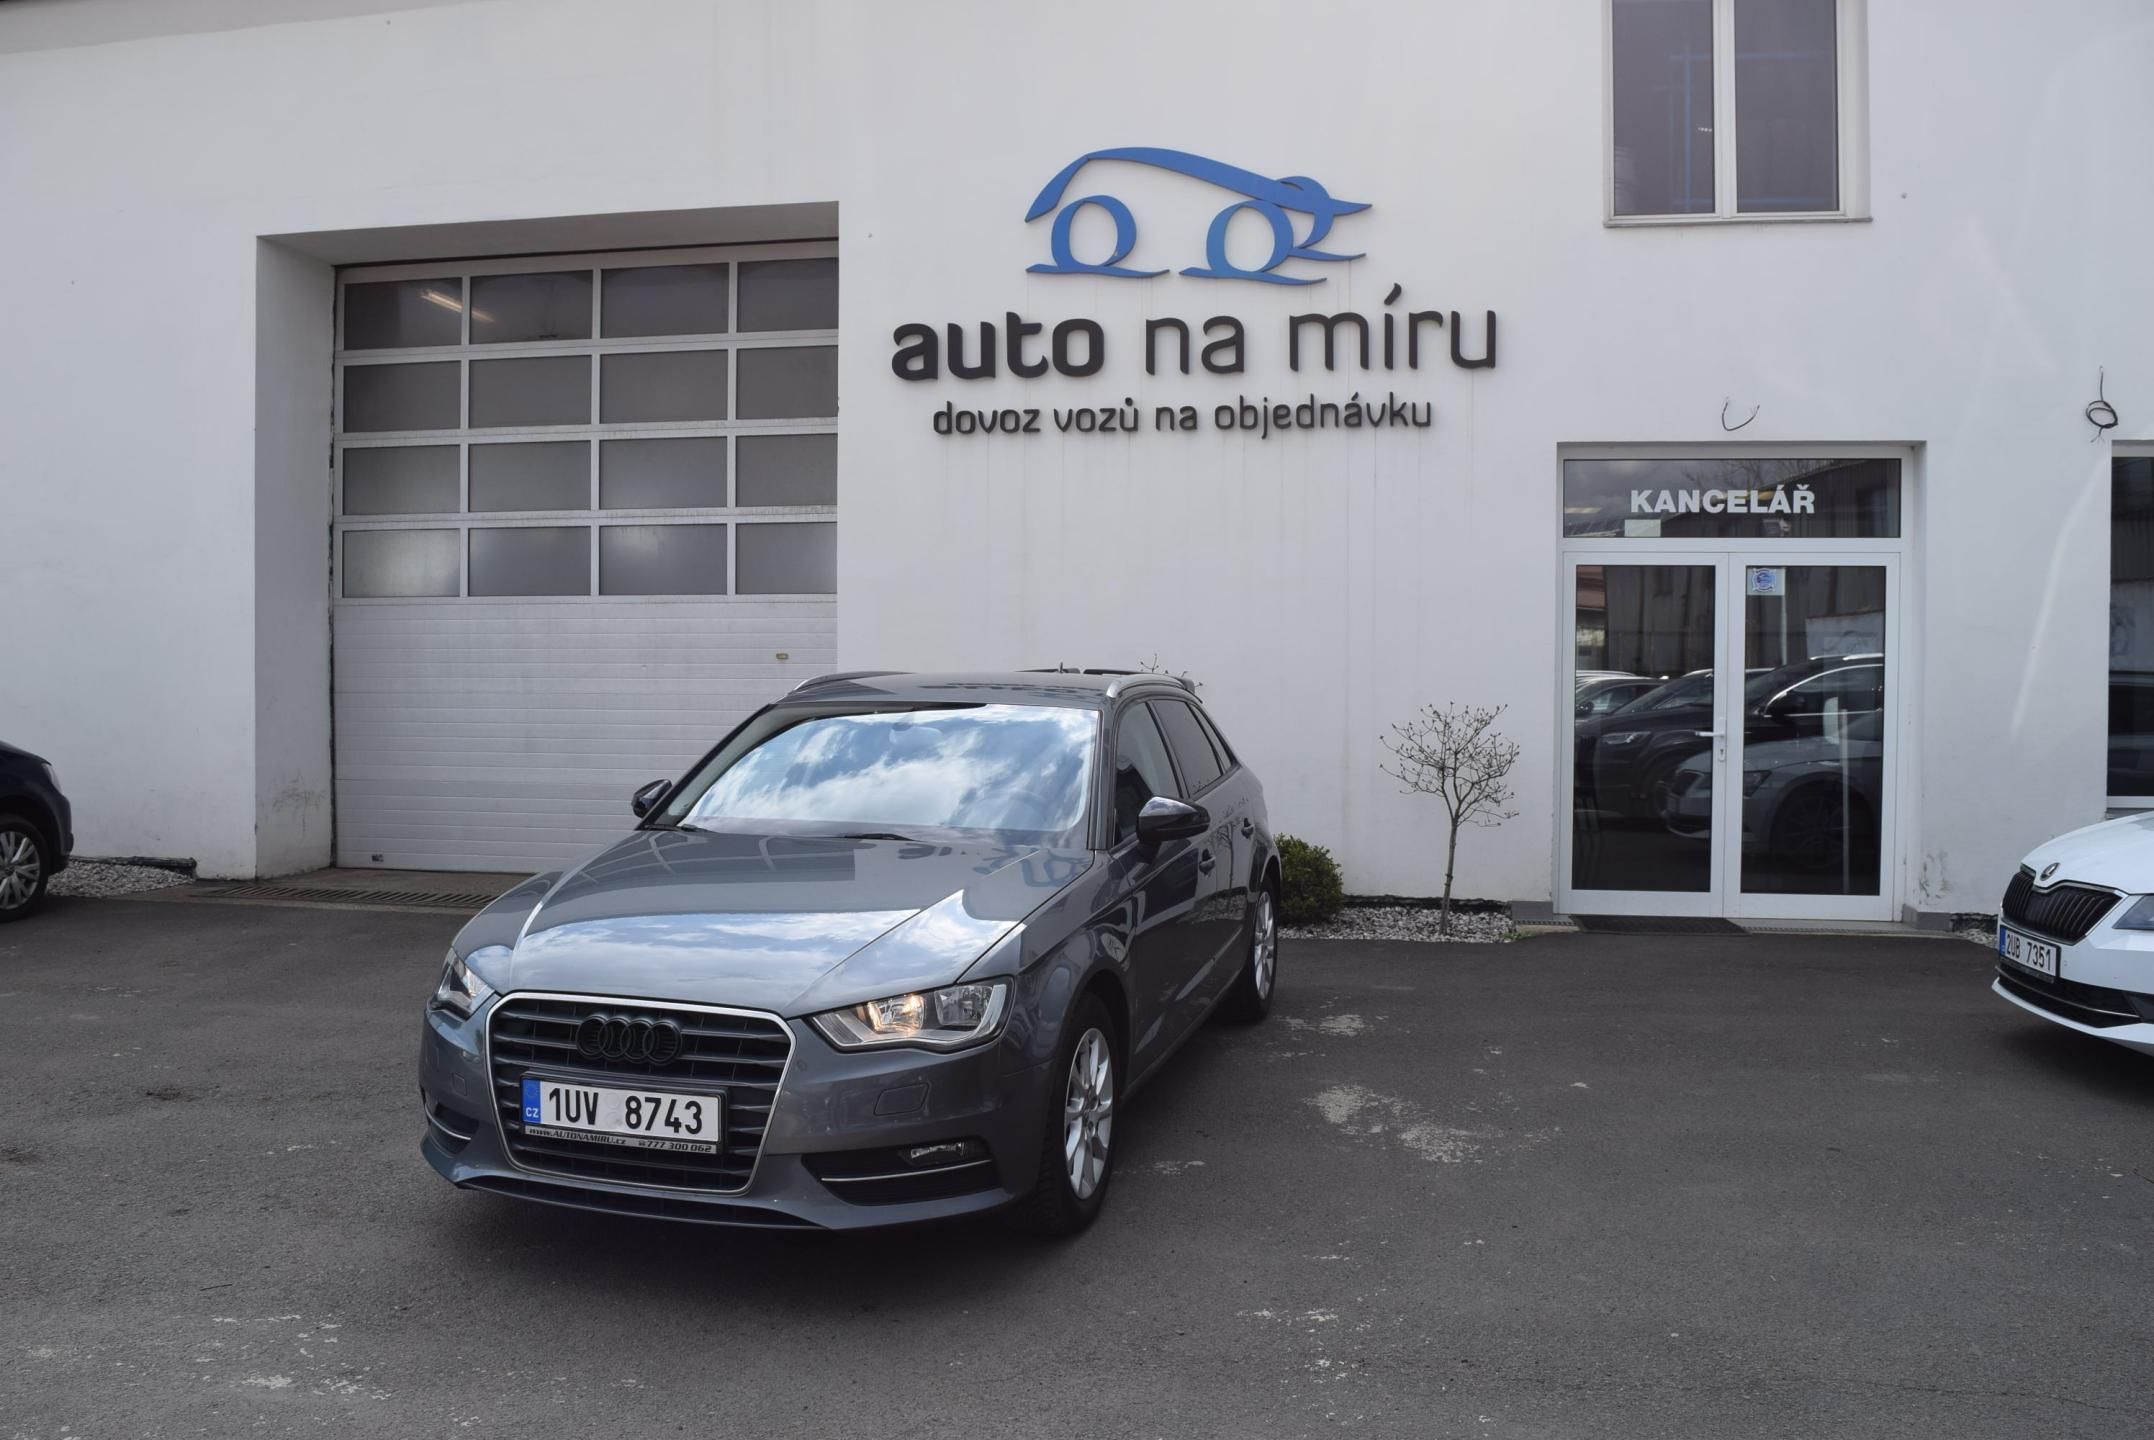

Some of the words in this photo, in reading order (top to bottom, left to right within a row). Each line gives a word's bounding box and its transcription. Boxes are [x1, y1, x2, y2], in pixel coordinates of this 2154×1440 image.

[891, 311, 1105, 381] auto
[1145, 314, 1245, 375] na
[1288, 283, 1497, 371] míru
[933, 401, 1041, 435] dovoz
[1053, 396, 1139, 433] vozů
[1155, 404, 1198, 431] na
[1214, 392, 1432, 440] objednávku
[1630, 484, 1816, 514] KANCELÁŘ
[2007, 933, 2020, 959] 2UB
[2026, 941, 2051, 971] 7351
[525, 1107, 540, 1118] CZ
[549, 1087, 599, 1126] 1UV
[625, 1095, 703, 1135] 8743
[647, 1140, 666, 1149] 777
[668, 1142, 689, 1151] 300
[690, 1144, 712, 1153] 062
